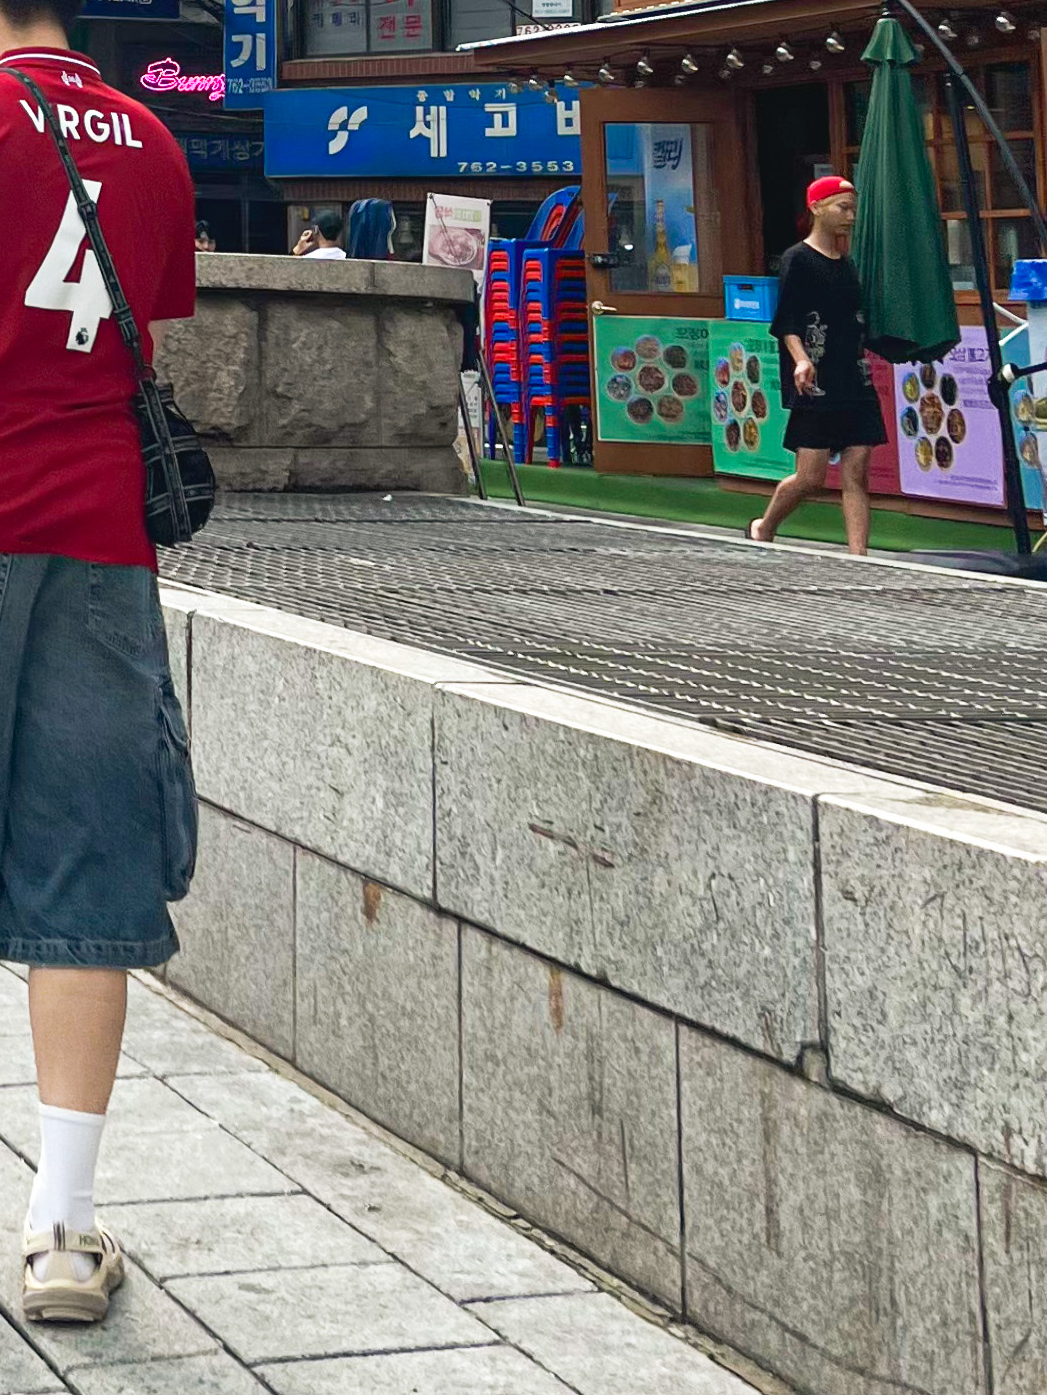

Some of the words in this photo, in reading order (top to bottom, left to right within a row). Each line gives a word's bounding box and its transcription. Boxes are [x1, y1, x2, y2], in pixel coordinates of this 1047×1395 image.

[19, 99, 143, 149] VRGIL
[457, 160, 575, 175] 762-3553
[25, 178, 114, 353] 4
